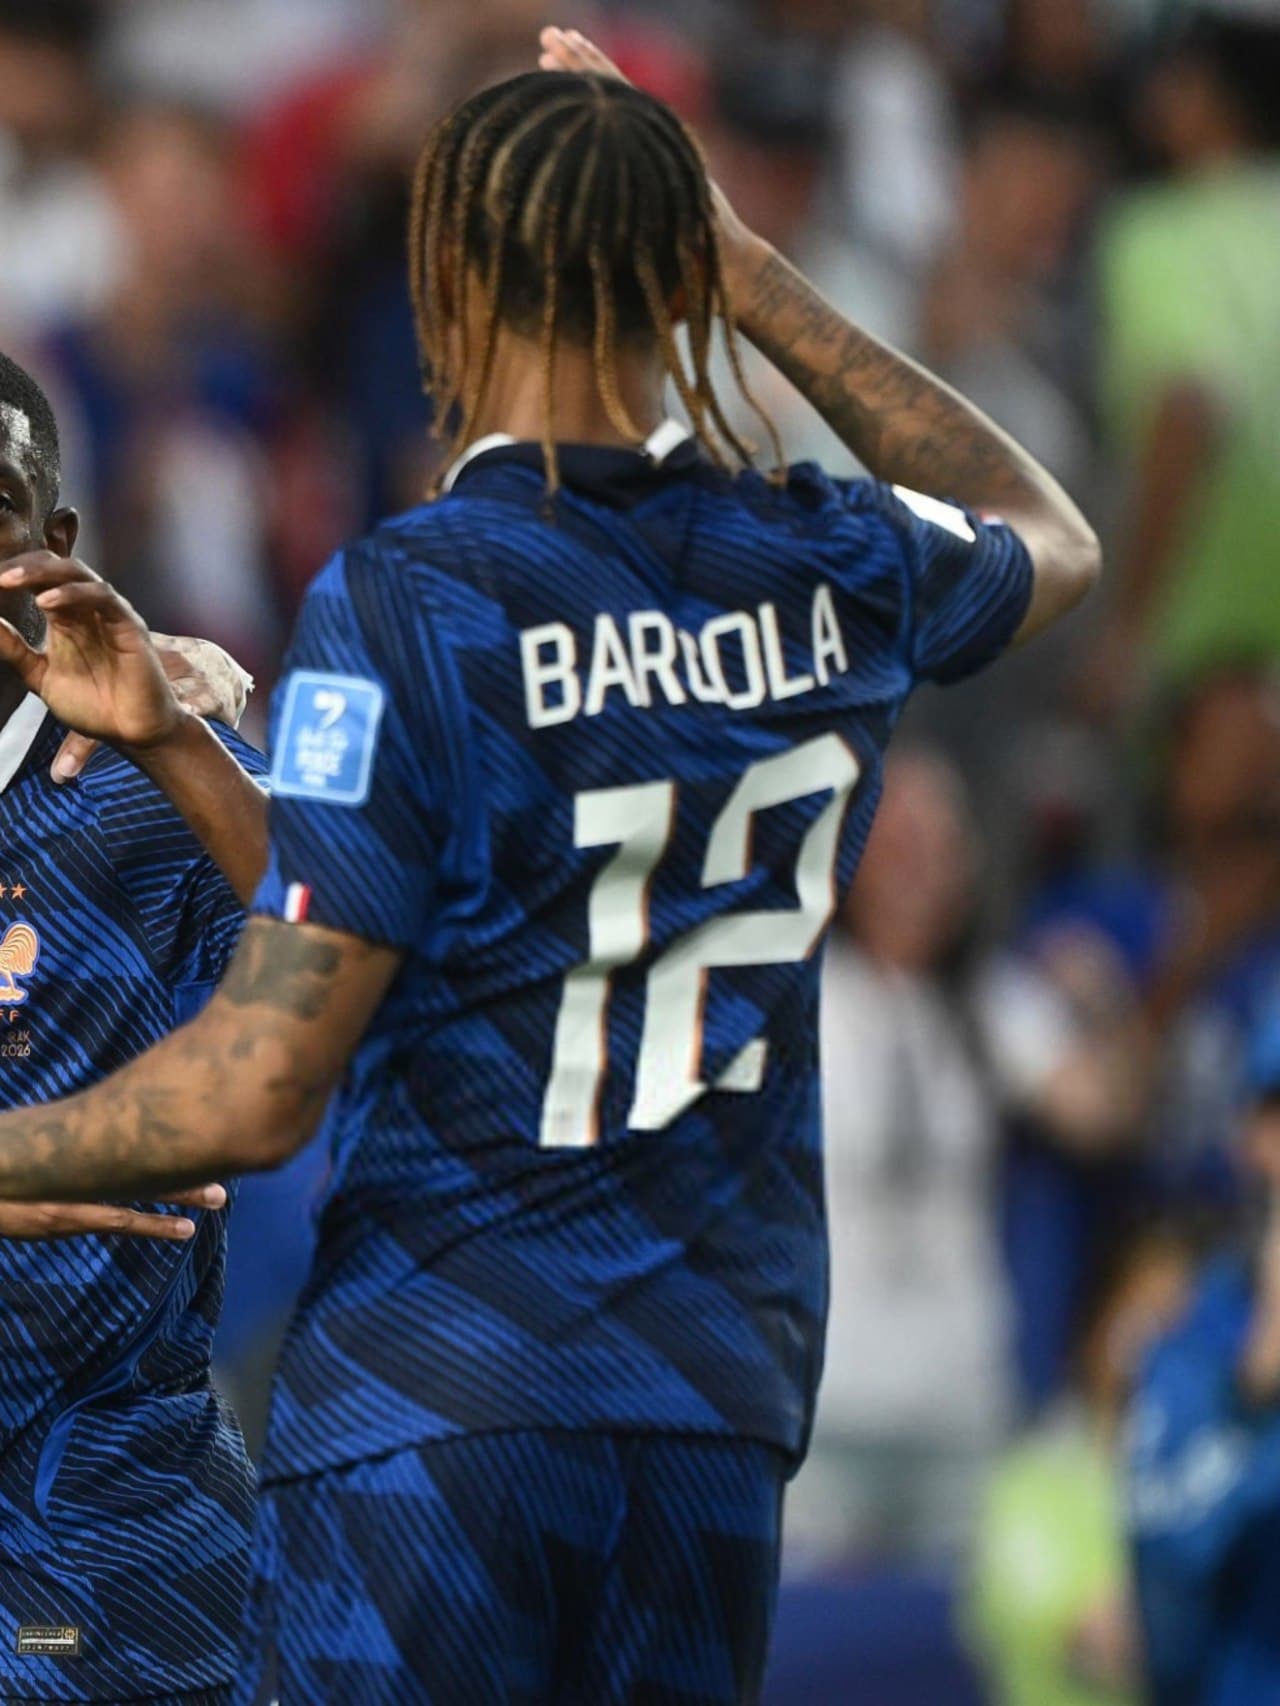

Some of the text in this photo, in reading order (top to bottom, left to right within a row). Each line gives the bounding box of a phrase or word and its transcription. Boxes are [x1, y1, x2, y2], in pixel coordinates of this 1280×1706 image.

[538, 732, 861, 1149] 12
[7, 1029, 31, 1042] RAK
[0, 1044, 31, 1057] 2026
